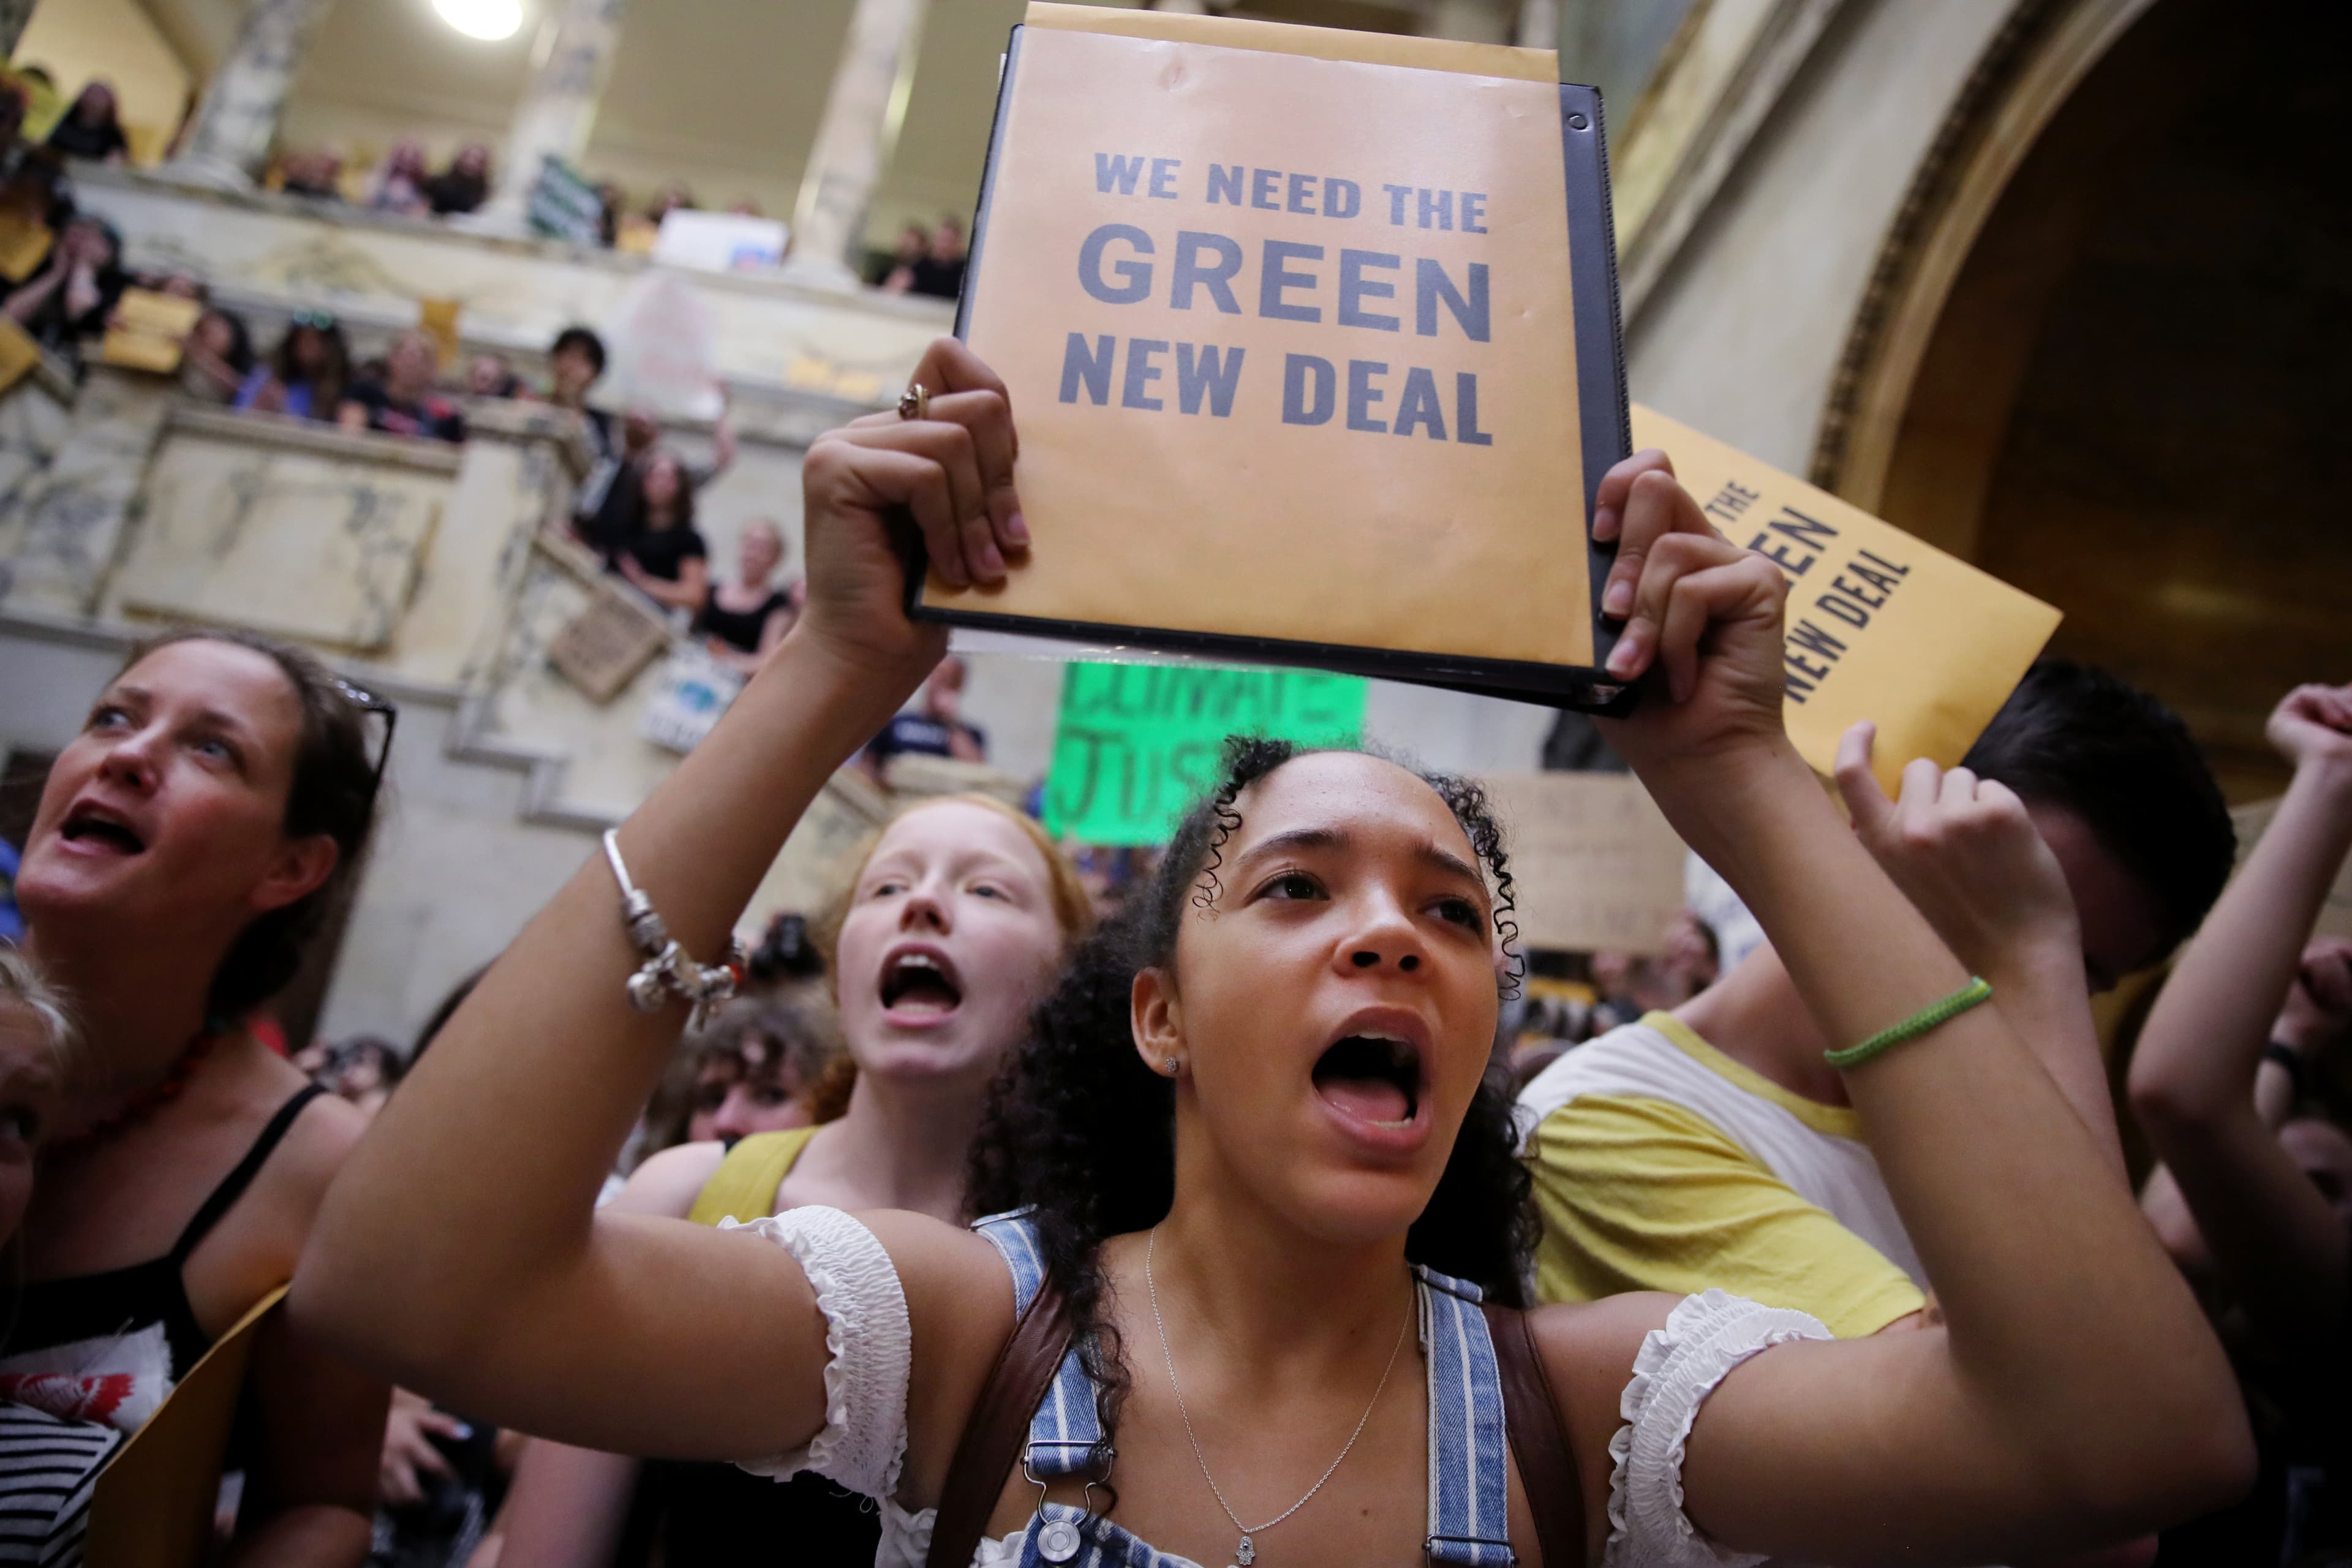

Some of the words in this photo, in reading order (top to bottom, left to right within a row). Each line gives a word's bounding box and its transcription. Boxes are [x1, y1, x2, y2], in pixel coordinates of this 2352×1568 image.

[1094, 152, 1182, 199] WE
[1205, 162, 1362, 219] NEED
[1382, 184, 1488, 235] THE
[1076, 222, 1492, 344] GREEN
[1058, 331, 1246, 418] NEW
[1281, 352, 1493, 447] DEAL
[1705, 481, 1761, 521] THE
[1815, 549, 1910, 630] DEAL
